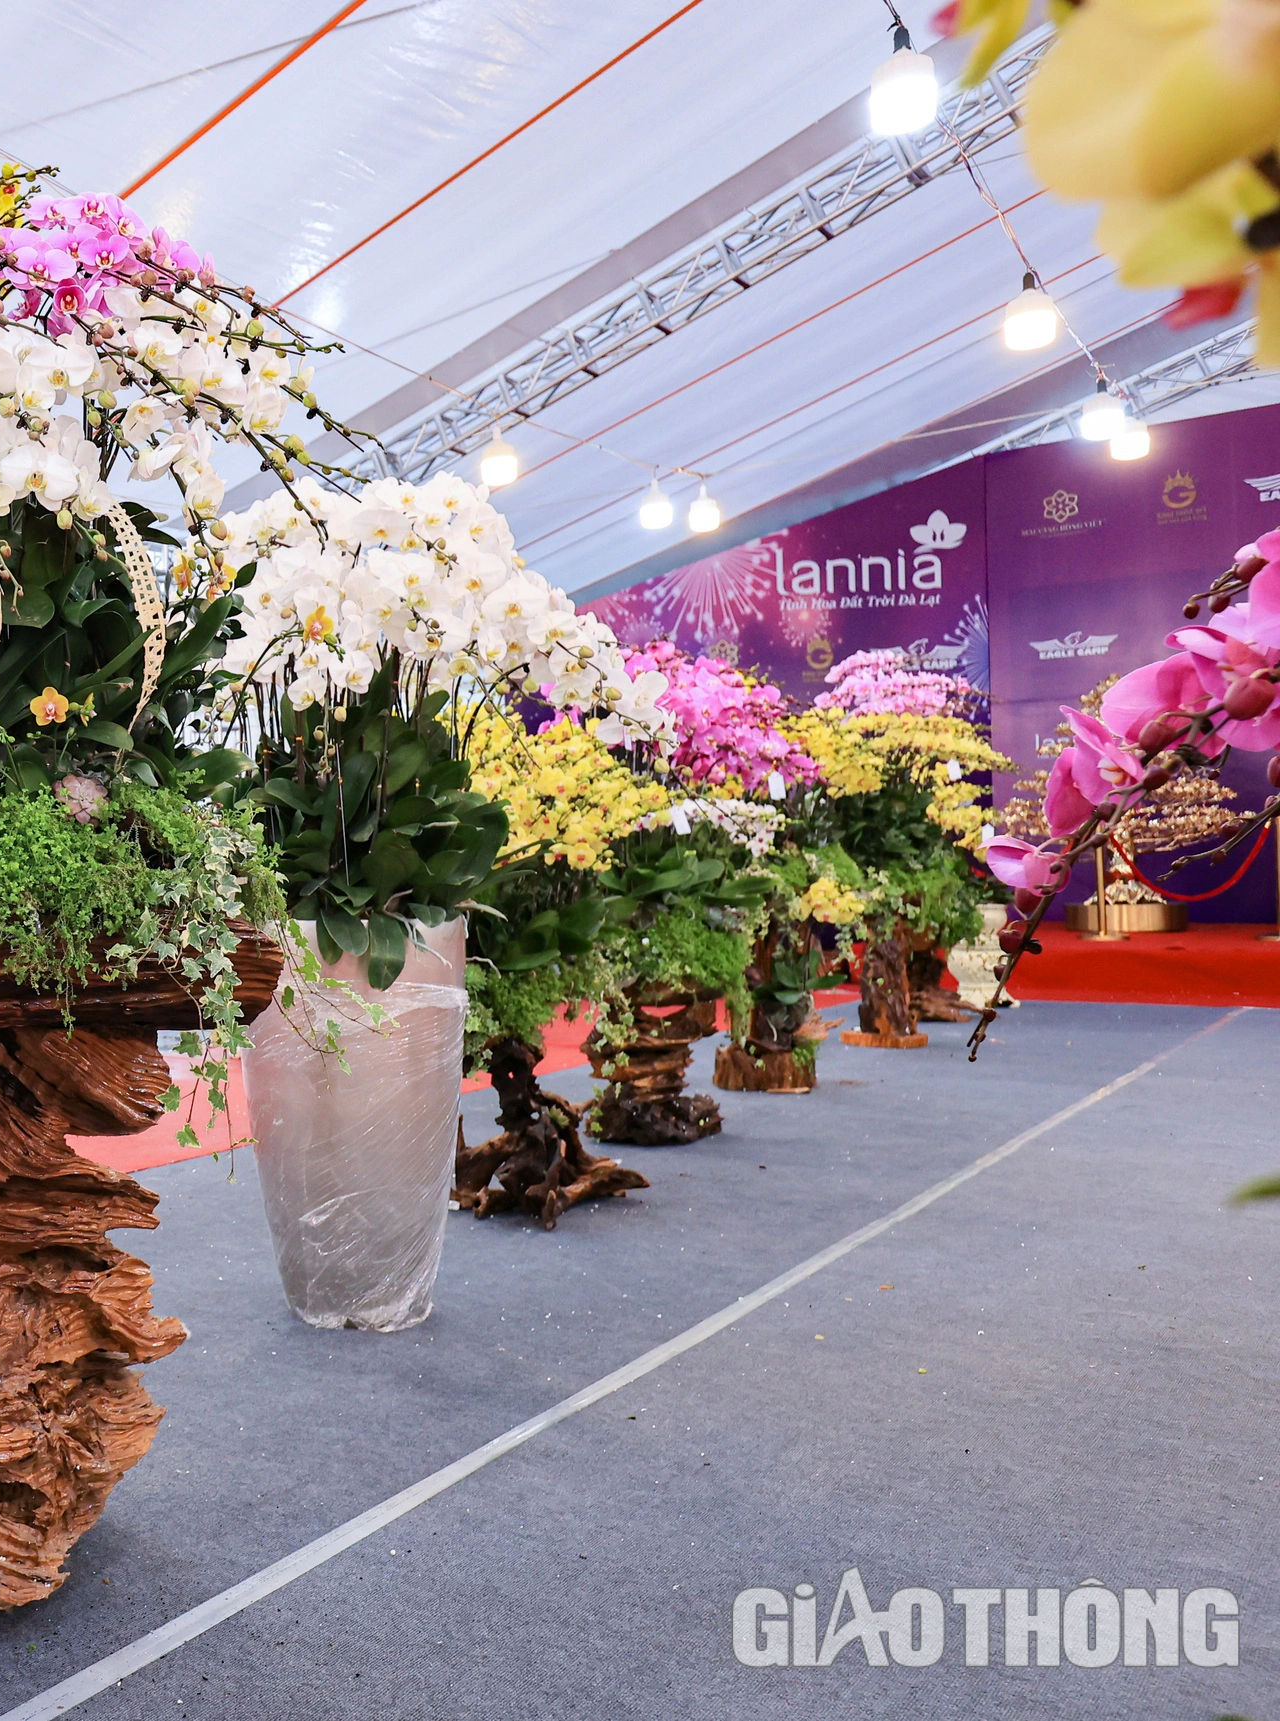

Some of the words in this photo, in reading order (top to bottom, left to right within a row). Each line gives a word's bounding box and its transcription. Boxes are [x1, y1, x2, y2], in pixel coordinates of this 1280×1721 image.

[775, 547, 943, 596] lannia
[840, 594, 864, 609] Đất
[898, 593, 917, 607] Đà
[919, 592, 942, 608] Lạt
[1039, 648, 1075, 660] EAGLE
[1077, 646, 1110, 657] CAMP
[923, 659, 959, 670] CAMP
